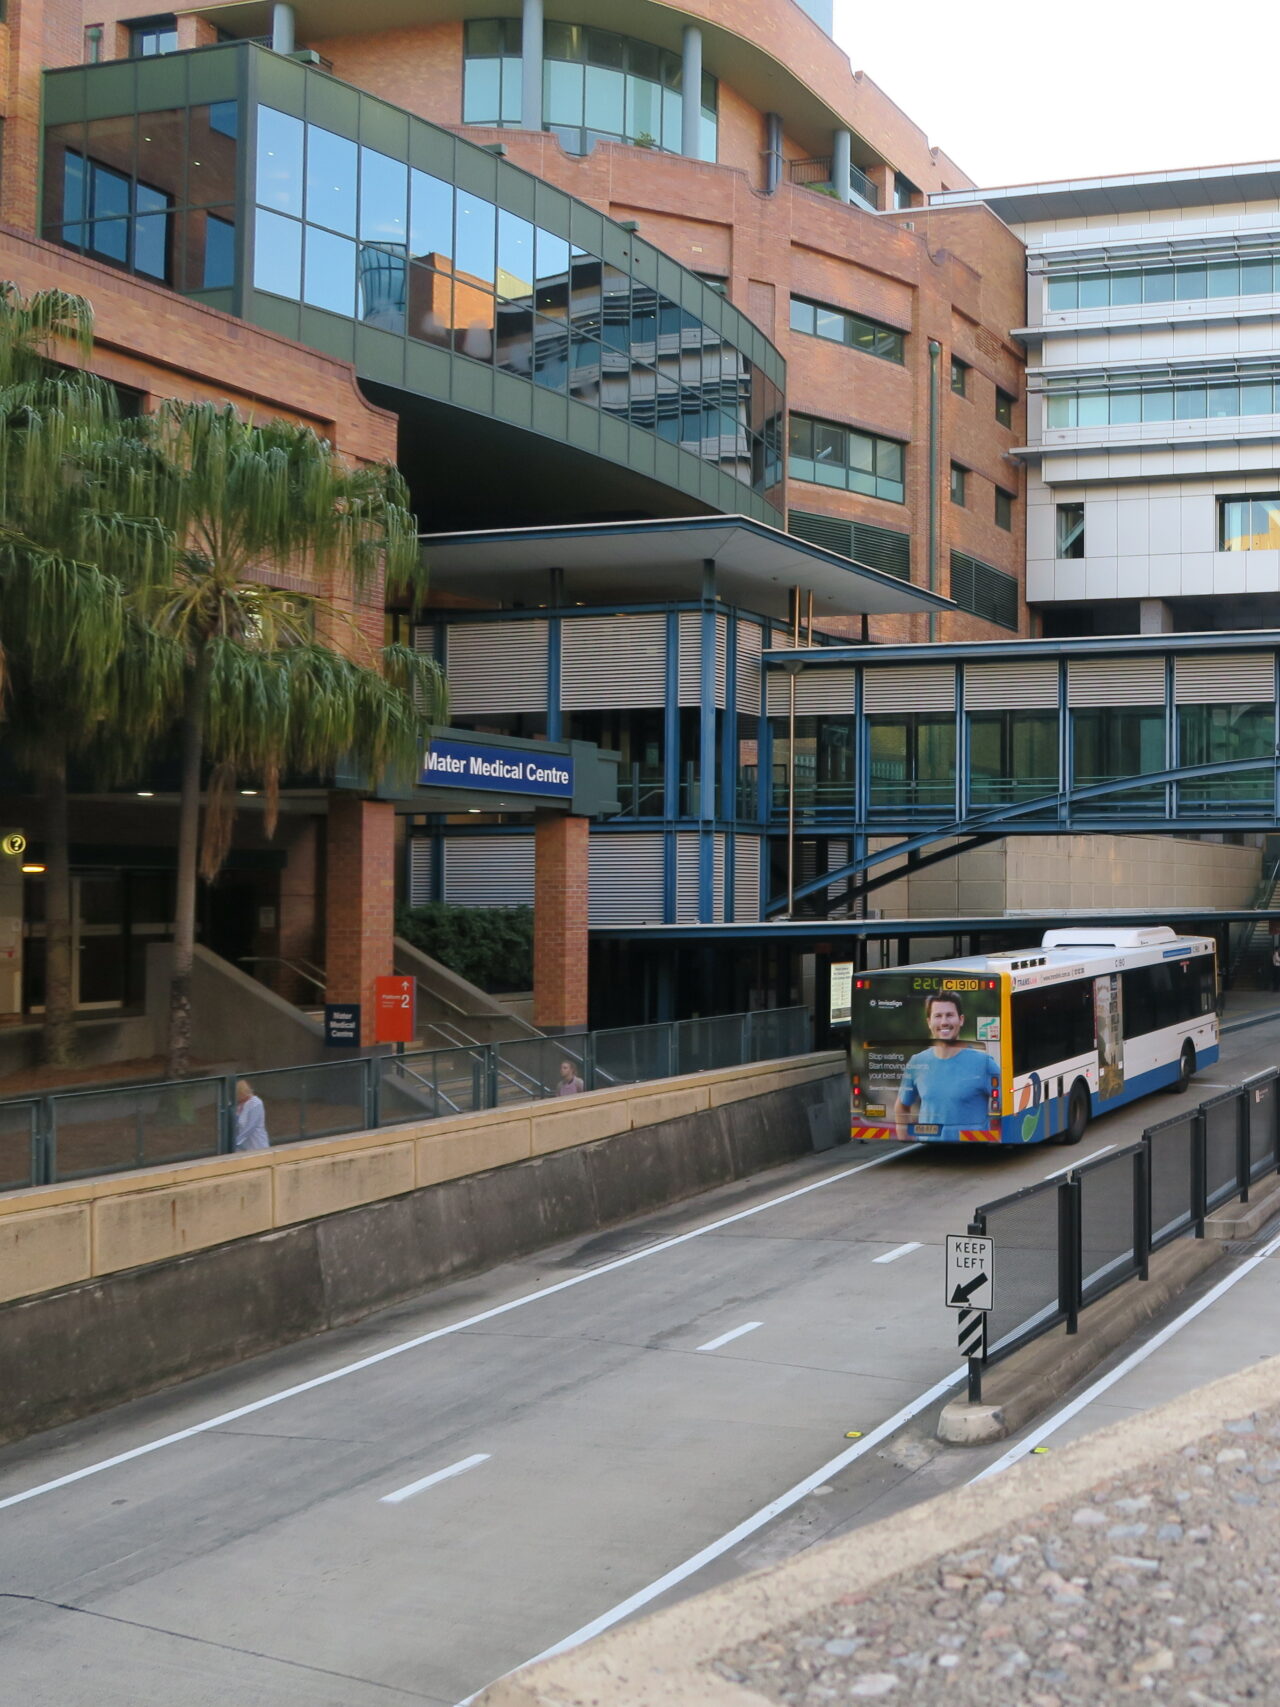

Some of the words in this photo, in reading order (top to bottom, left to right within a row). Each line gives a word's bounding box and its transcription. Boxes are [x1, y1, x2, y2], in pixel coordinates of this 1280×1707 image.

[425, 752, 466, 773] Mater
[470, 757, 523, 780] Medical
[526, 764, 569, 784] Centre
[945, 980, 977, 990] C1910
[401, 994, 410, 1009] 2
[868, 1052, 883, 1061] Stop
[868, 1062, 883, 1070] Start
[884, 1063, 906, 1071] moving
[956, 1242, 986, 1254] KEEP
[956, 1257, 985, 1269] LEFT
